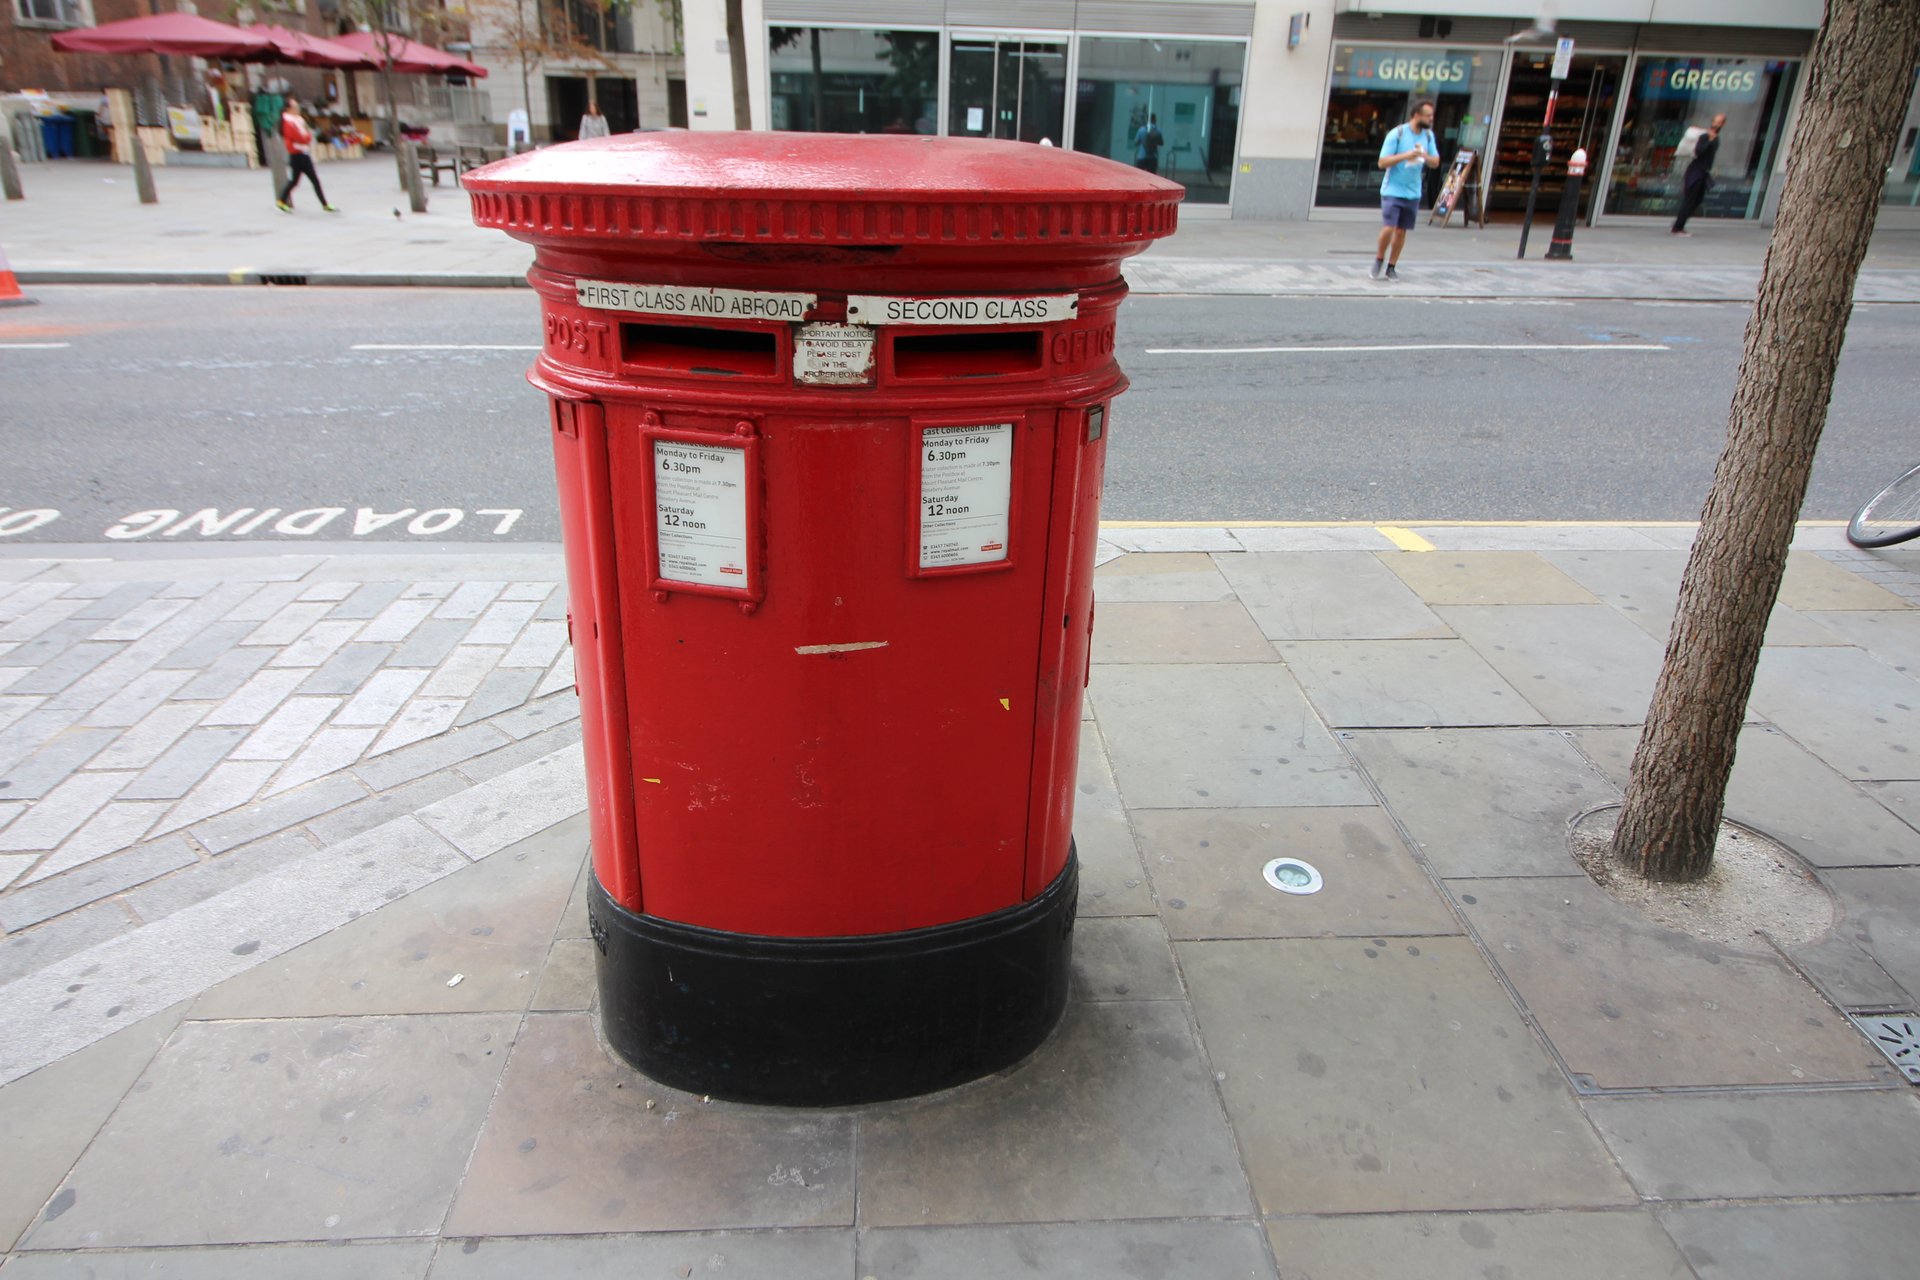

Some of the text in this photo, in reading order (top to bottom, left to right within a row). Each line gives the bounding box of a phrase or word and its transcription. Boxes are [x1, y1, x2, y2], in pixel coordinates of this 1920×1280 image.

[1378, 57, 1465, 82] GREGGS
[1670, 67, 1756, 92] GREGGS
[587, 287, 803, 317] FIRST CLASS AND ABROAD
[887, 300, 1048, 319] SECOND CLASS
[546, 311, 610, 358] POST
[799, 330, 873, 338] PORTANT NOTICE
[815, 340, 840, 348] AVOID
[842, 340, 868, 348] DELAY
[806, 350, 837, 358] PLEASE
[922, 440, 954, 448] Monday
[965, 436, 990, 444] Friday
[656, 448, 688, 459] Monday
[699, 452, 725, 463] Friday
[928, 450, 966, 462] 6.30pm
[662, 459, 701, 474] 6.30pm
[922, 494, 959, 504] Saturday
[658, 504, 694, 516] Saturday
[928, 504, 970, 516] 12 noon
[104, 507, 524, 540] LOADING
[664, 514, 706, 529] 12 noon
